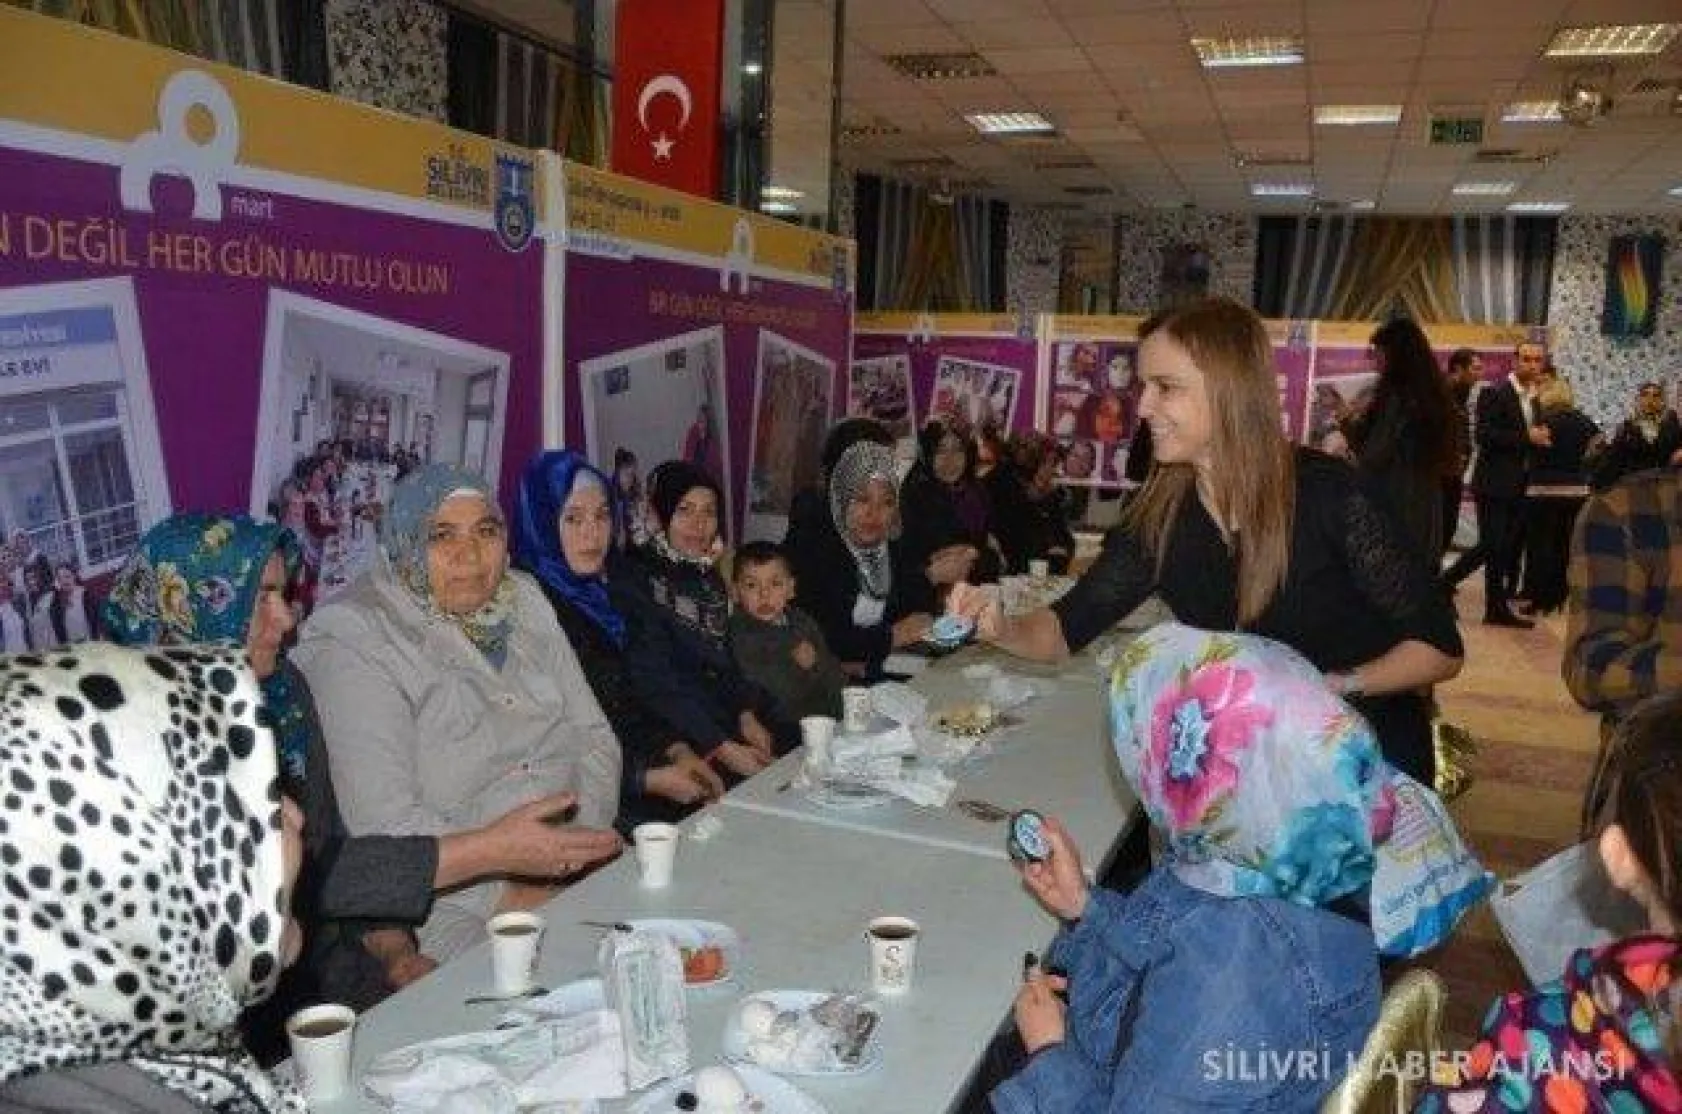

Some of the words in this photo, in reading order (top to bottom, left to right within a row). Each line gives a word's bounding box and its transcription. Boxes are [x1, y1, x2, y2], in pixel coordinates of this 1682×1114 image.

[230, 196, 274, 219] mart
[25, 215, 140, 268] DEĞİL
[148, 233, 214, 272] HER
[221, 234, 287, 280] GÜN
[295, 248, 382, 288] MUTLU
[388, 259, 449, 293] OLUN
